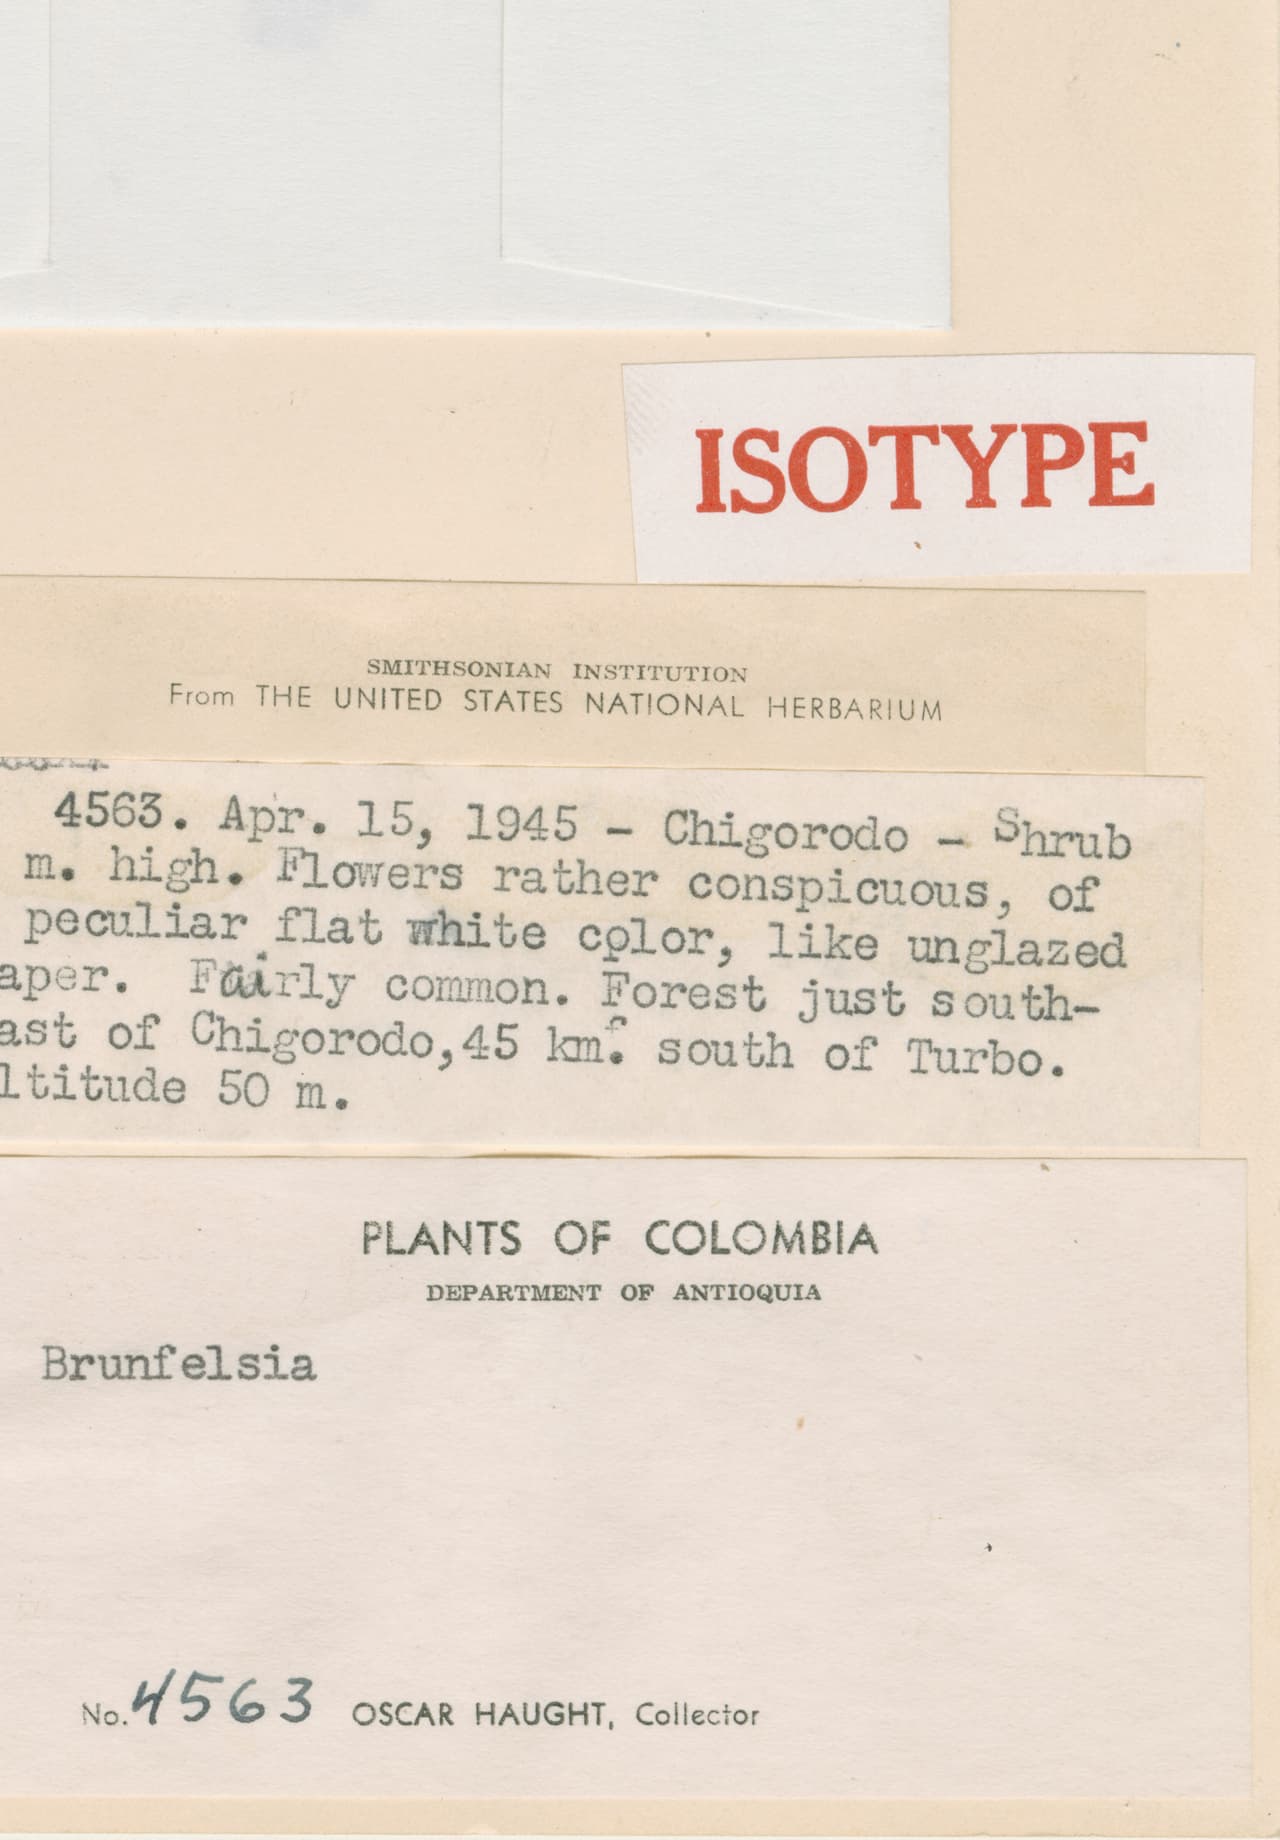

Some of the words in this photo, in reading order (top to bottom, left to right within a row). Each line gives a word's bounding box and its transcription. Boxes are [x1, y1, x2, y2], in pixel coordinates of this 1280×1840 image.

[694, 420, 1155, 515] ISOTYPE
[367, 658, 551, 679] SMITHSONIAN
[573, 663, 747, 683] INSTITUTION
[170, 682, 234, 706] From
[255, 684, 311, 708] THE
[335, 686, 442, 711] UNITED
[464, 688, 563, 714] STATES
[586, 691, 745, 718] NATIONAL
[768, 696, 942, 721] HERBARIUM
[53, 790, 188, 831] 4563.
[218, 794, 327, 844] Apr.
[357, 800, 432, 851] 15,
[466, 803, 578, 842] 1945
[664, 808, 909, 860] Chigorodo
[994, 806, 1133, 861] Shrub
[23, 853, 75, 882] m.
[109, 844, 244, 895] high.
[276, 846, 464, 891] Flowers
[493, 858, 660, 898] rather
[688, 867, 1011, 921] conspicuous,
[1048, 875, 1101, 913] of
[23, 900, 249, 945] peculiar
[275, 906, 383, 946] flat
[406, 908, 547, 951] white
[768, 921, 879, 962] like
[907, 928, 1128, 975] unglazed
[189, 950, 357, 1010] Fairly
[386, 974, 569, 1006] common.
[601, 970, 767, 1013] Forest
[798, 978, 907, 1024] just
[108, 1012, 161, 1051] of
[658, 1031, 795, 1069] south
[825, 1035, 879, 1072] of
[906, 1037, 1064, 1078] Turbo.
[218, 1068, 270, 1108] 50
[295, 1081, 349, 1111] m.
[362, 1219, 522, 1256] PLANTS
[554, 1219, 611, 1256] OF
[644, 1219, 879, 1257] COLOMBIA
[425, 1283, 603, 1302] DEPARTMENT
[620, 1283, 655, 1302] OF
[672, 1283, 822, 1305] ANTIOQUIA
[41, 1343, 318, 1382] Brunfelsia
[351, 1701, 455, 1727] OSCAR
[475, 1700, 614, 1731] HAUGHT,
[635, 1701, 760, 1727] Collector
